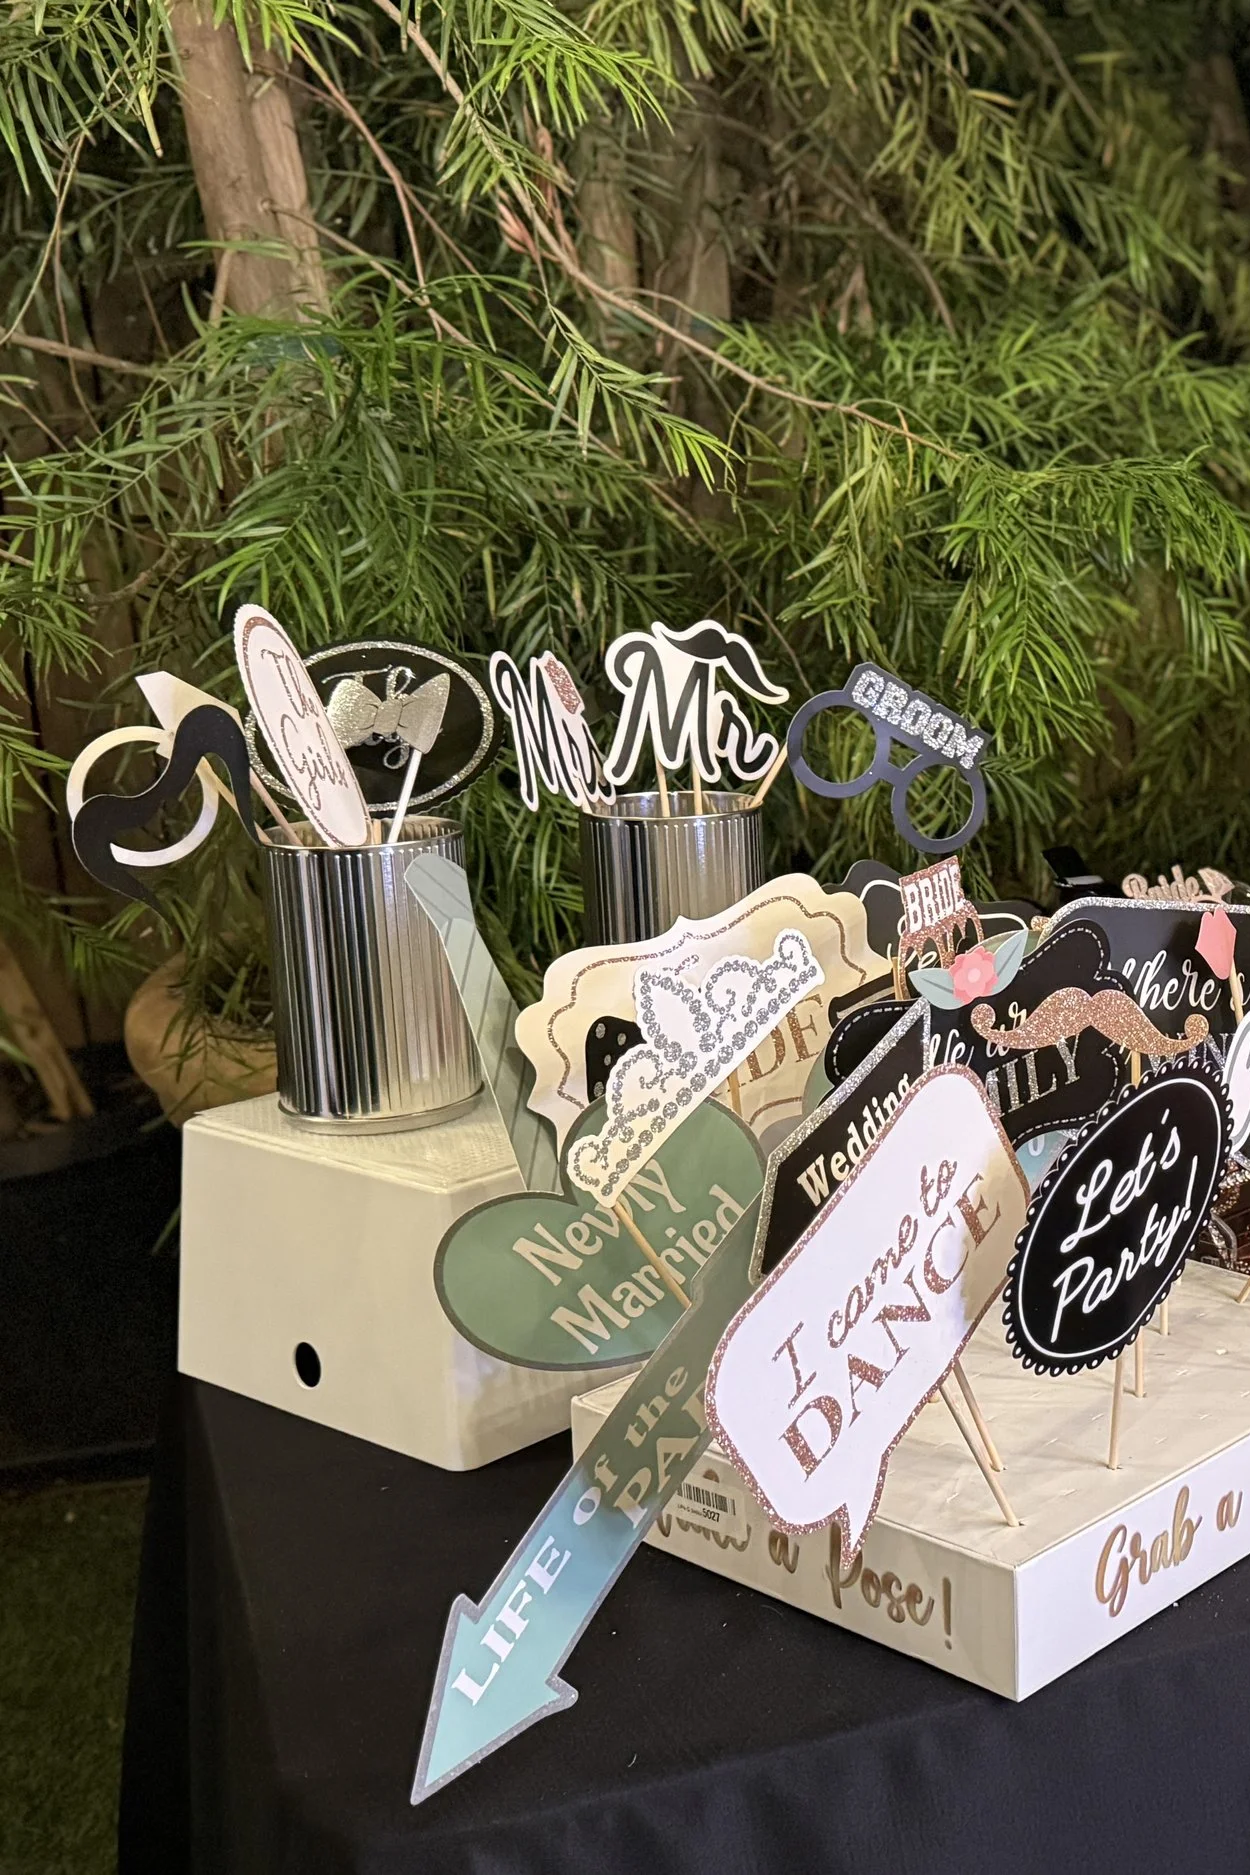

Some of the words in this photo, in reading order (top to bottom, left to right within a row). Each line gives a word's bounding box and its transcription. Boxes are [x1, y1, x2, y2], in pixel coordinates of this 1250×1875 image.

[611, 639, 774, 779] Mr
[852, 669, 986, 770] GROOM
[903, 863, 966, 934] BRIDE
[796, 1073, 912, 1208] Wedding
[1060, 1108, 1181, 1253] Let's
[771, 1321, 818, 1410] I
[827, 1214, 919, 1349] came
[920, 1158, 959, 1218] to
[1050, 1155, 1198, 1344] Party!
[778, 1172, 1002, 1482] DANCE
[452, 1535, 572, 1707] LIFE
[623, 1366, 690, 1448] the
[702, 1507, 720, 1522] 5027
[768, 1528, 800, 1575] a
[1095, 1485, 1203, 1618] Grab
[1216, 1490, 1244, 1532] a
